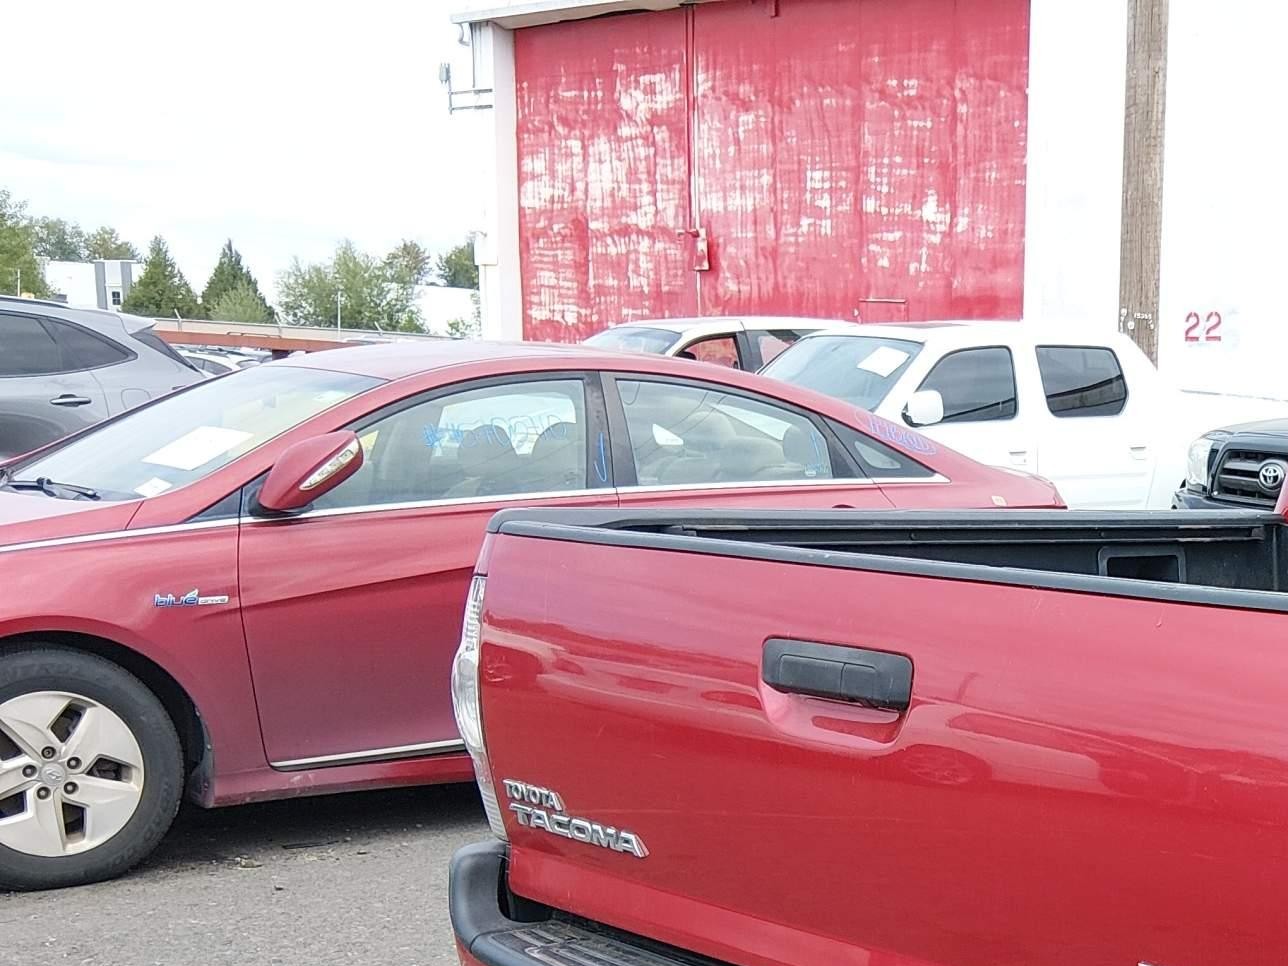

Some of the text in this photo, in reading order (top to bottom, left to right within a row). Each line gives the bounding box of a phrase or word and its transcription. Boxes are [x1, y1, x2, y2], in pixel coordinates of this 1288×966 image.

[1184, 311, 1222, 342] 22
[155, 589, 199, 607] blue
[502, 778, 566, 811] TOYOTA
[509, 802, 650, 858] TACOMA
